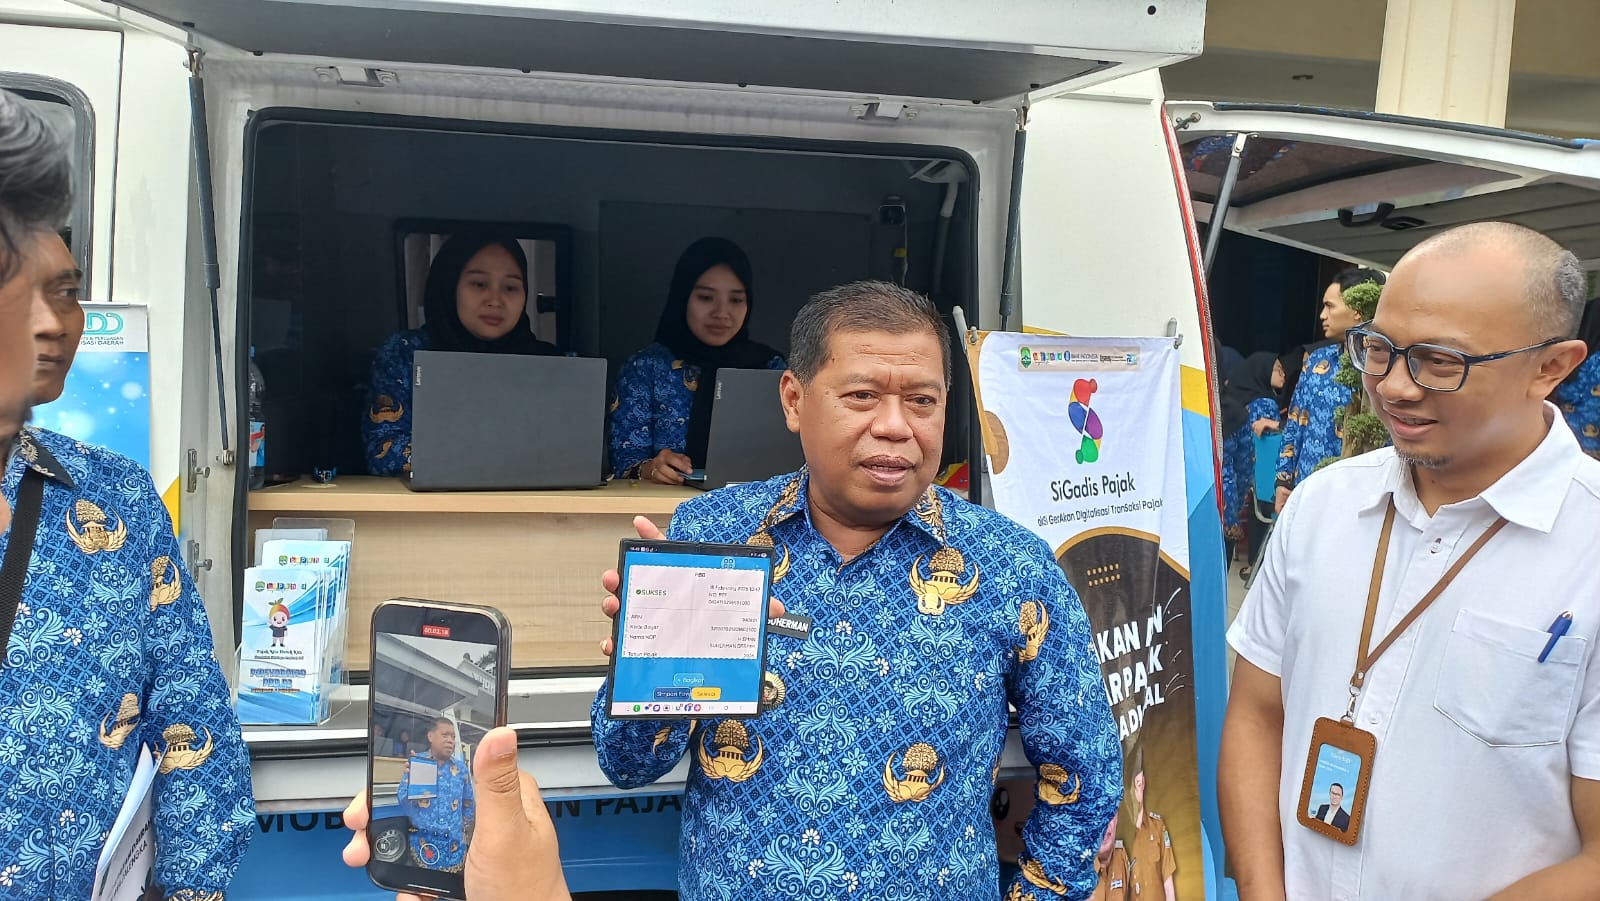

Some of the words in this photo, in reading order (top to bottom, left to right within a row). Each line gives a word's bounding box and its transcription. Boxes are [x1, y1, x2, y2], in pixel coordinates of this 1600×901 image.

[1050, 476, 1099, 502] SiGadis
[1101, 472, 1136, 498] Pajak
[1142, 497, 1163, 512] Pajak
[594, 794, 682, 817] PAJA
